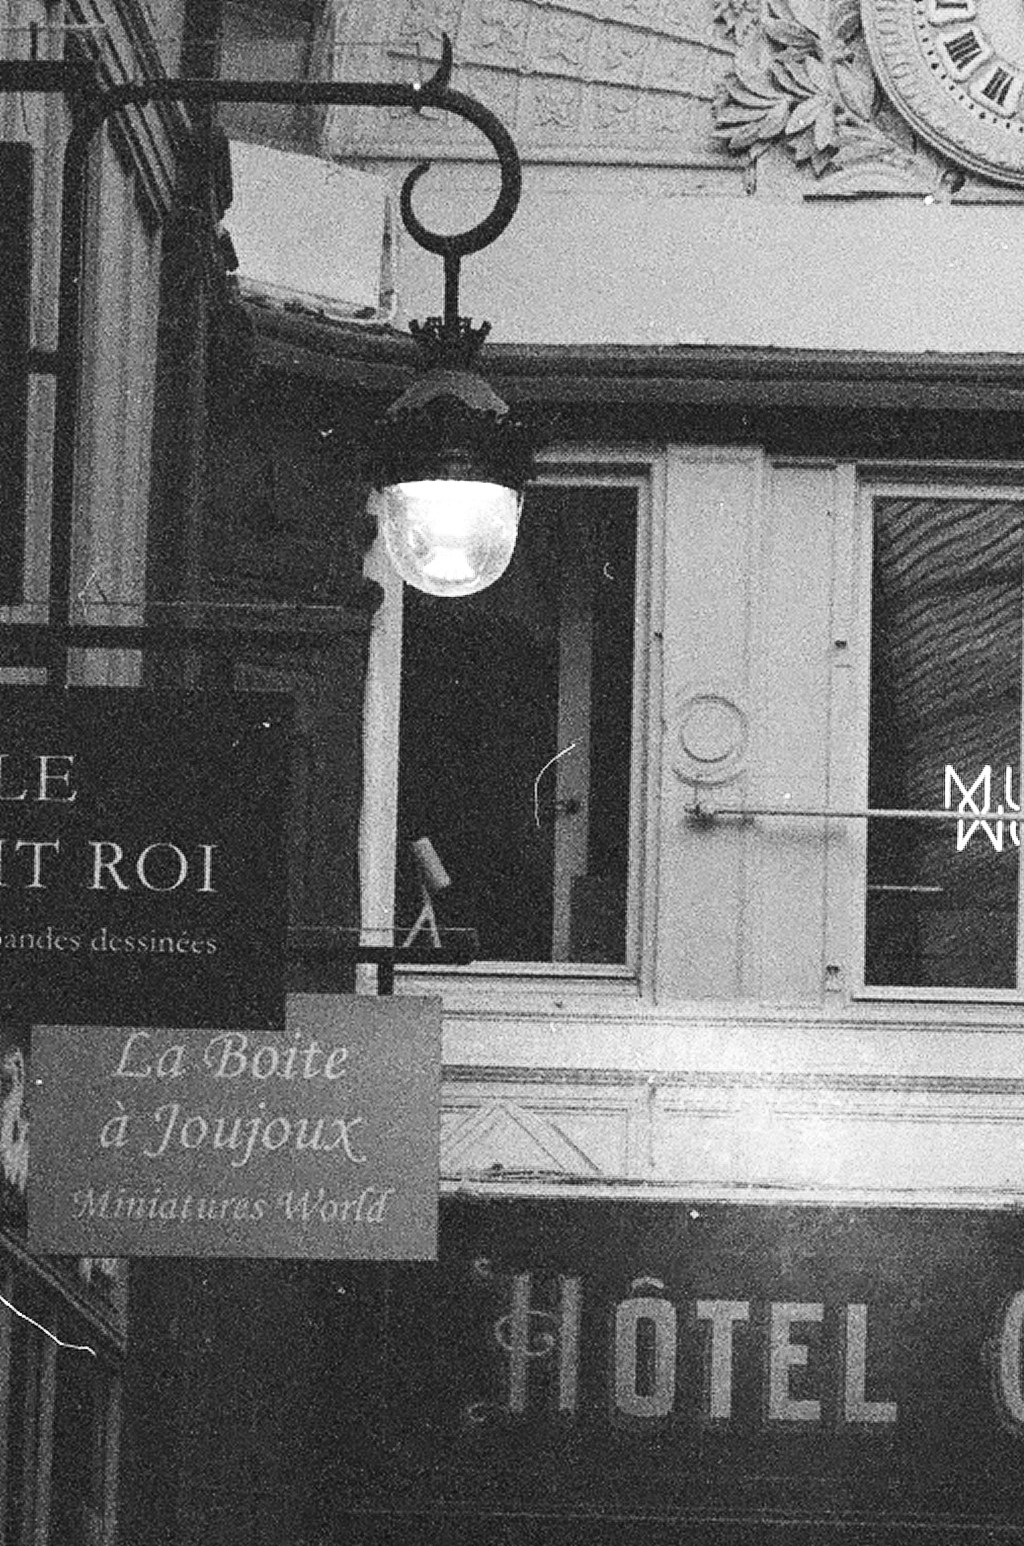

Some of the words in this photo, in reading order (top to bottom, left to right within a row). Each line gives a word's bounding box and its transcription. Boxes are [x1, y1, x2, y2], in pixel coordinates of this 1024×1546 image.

[87, 840, 219, 892] ROI
[0, 926, 81, 951] andes
[91, 927, 218, 955] dessinées
[112, 1031, 187, 1078] La
[100, 1100, 129, 1148] à
[143, 1102, 367, 1168] Joujoux
[72, 1186, 272, 1220] Miniatures
[281, 1186, 396, 1224] World
[495, 1271, 897, 1423] HÔTEL
